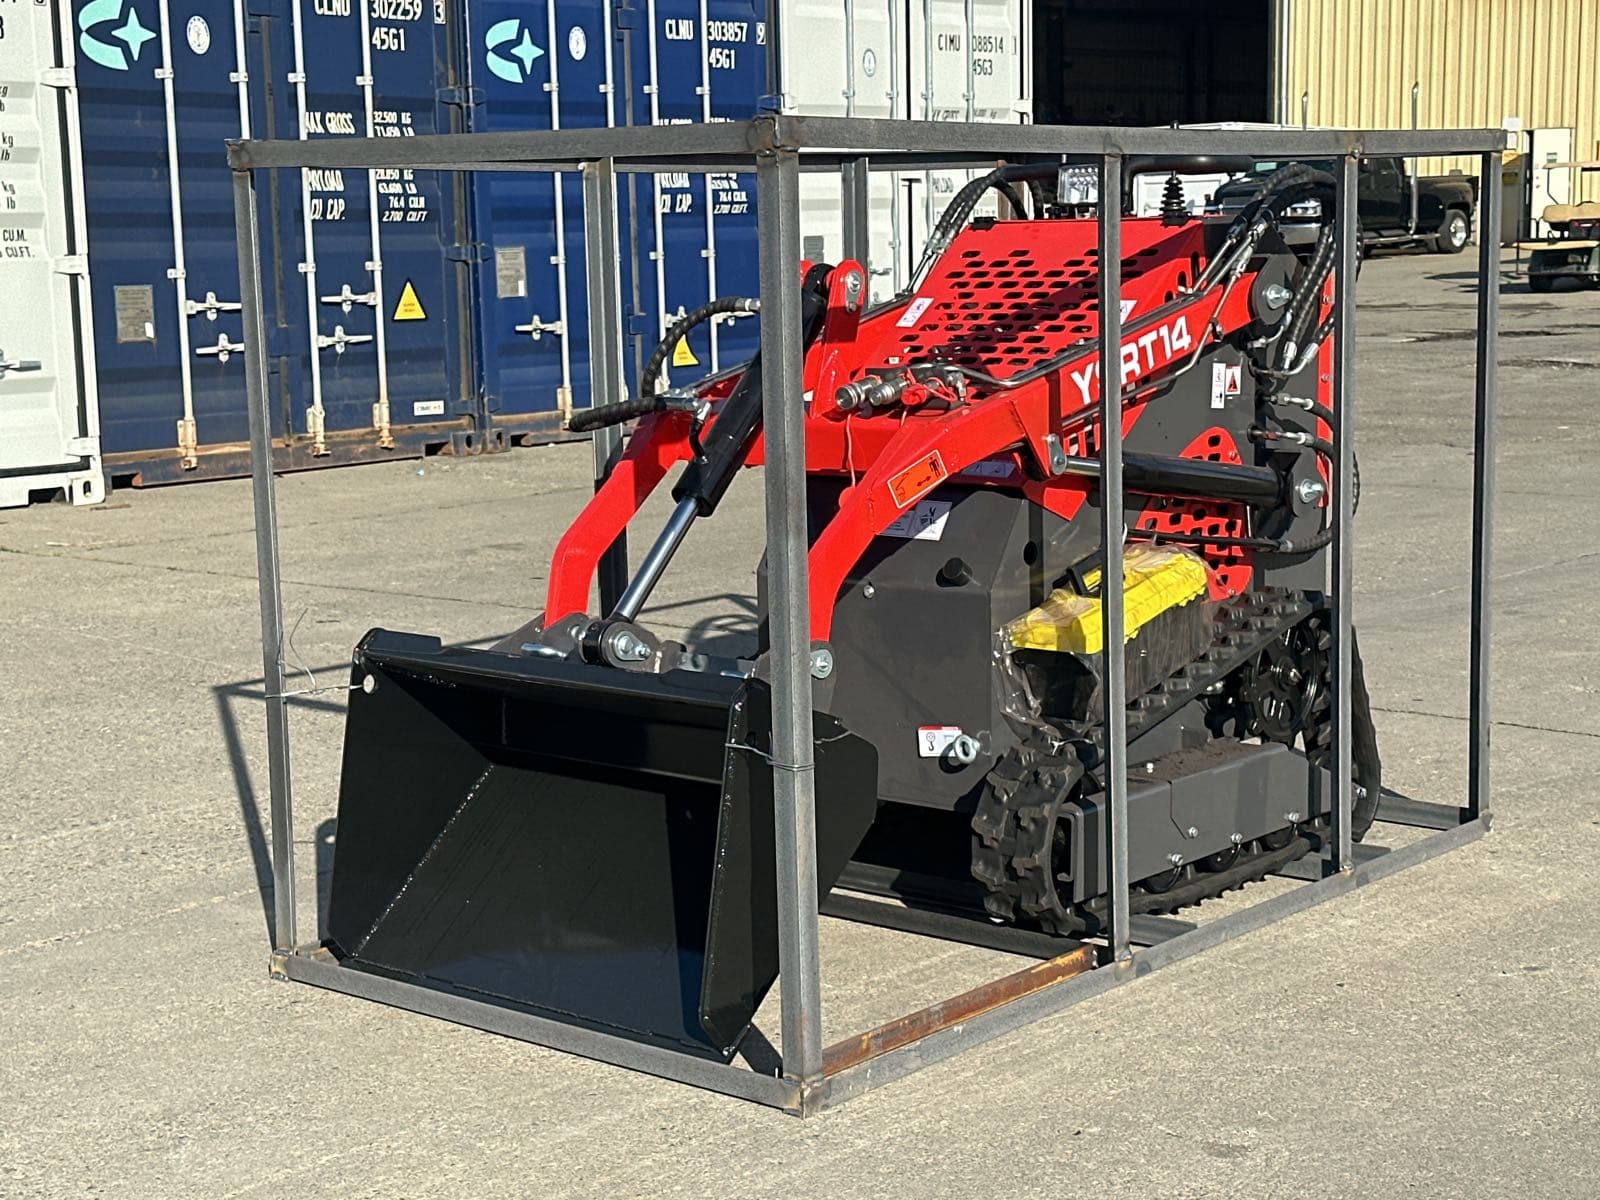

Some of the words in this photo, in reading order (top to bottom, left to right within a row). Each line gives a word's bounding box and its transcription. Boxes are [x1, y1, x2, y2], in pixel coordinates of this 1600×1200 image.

[314, 0, 351, 17] CLNU
[371, 0, 423, 21] 302259
[434, 1, 445, 23] 3
[371, 27, 406, 51] 45G1
[664, 19, 694, 40] CLNU
[708, 21, 748, 42] 303857
[756, 23, 766, 44] 9
[938, 33, 961, 52] CIMU
[709, 48, 736, 70] 45G1
[972, 58, 993, 76] 45G3
[325, 112, 356, 134] GROSS
[401, 112, 412, 124] KG
[2, 132, 14, 148] kg
[1, 149, 10, 161] lb
[2, 181, 16, 195] kg
[6, 197, 16, 209] lb
[326, 198, 346, 220] CAP.
[1070, 315, 1192, 406] YRT14
